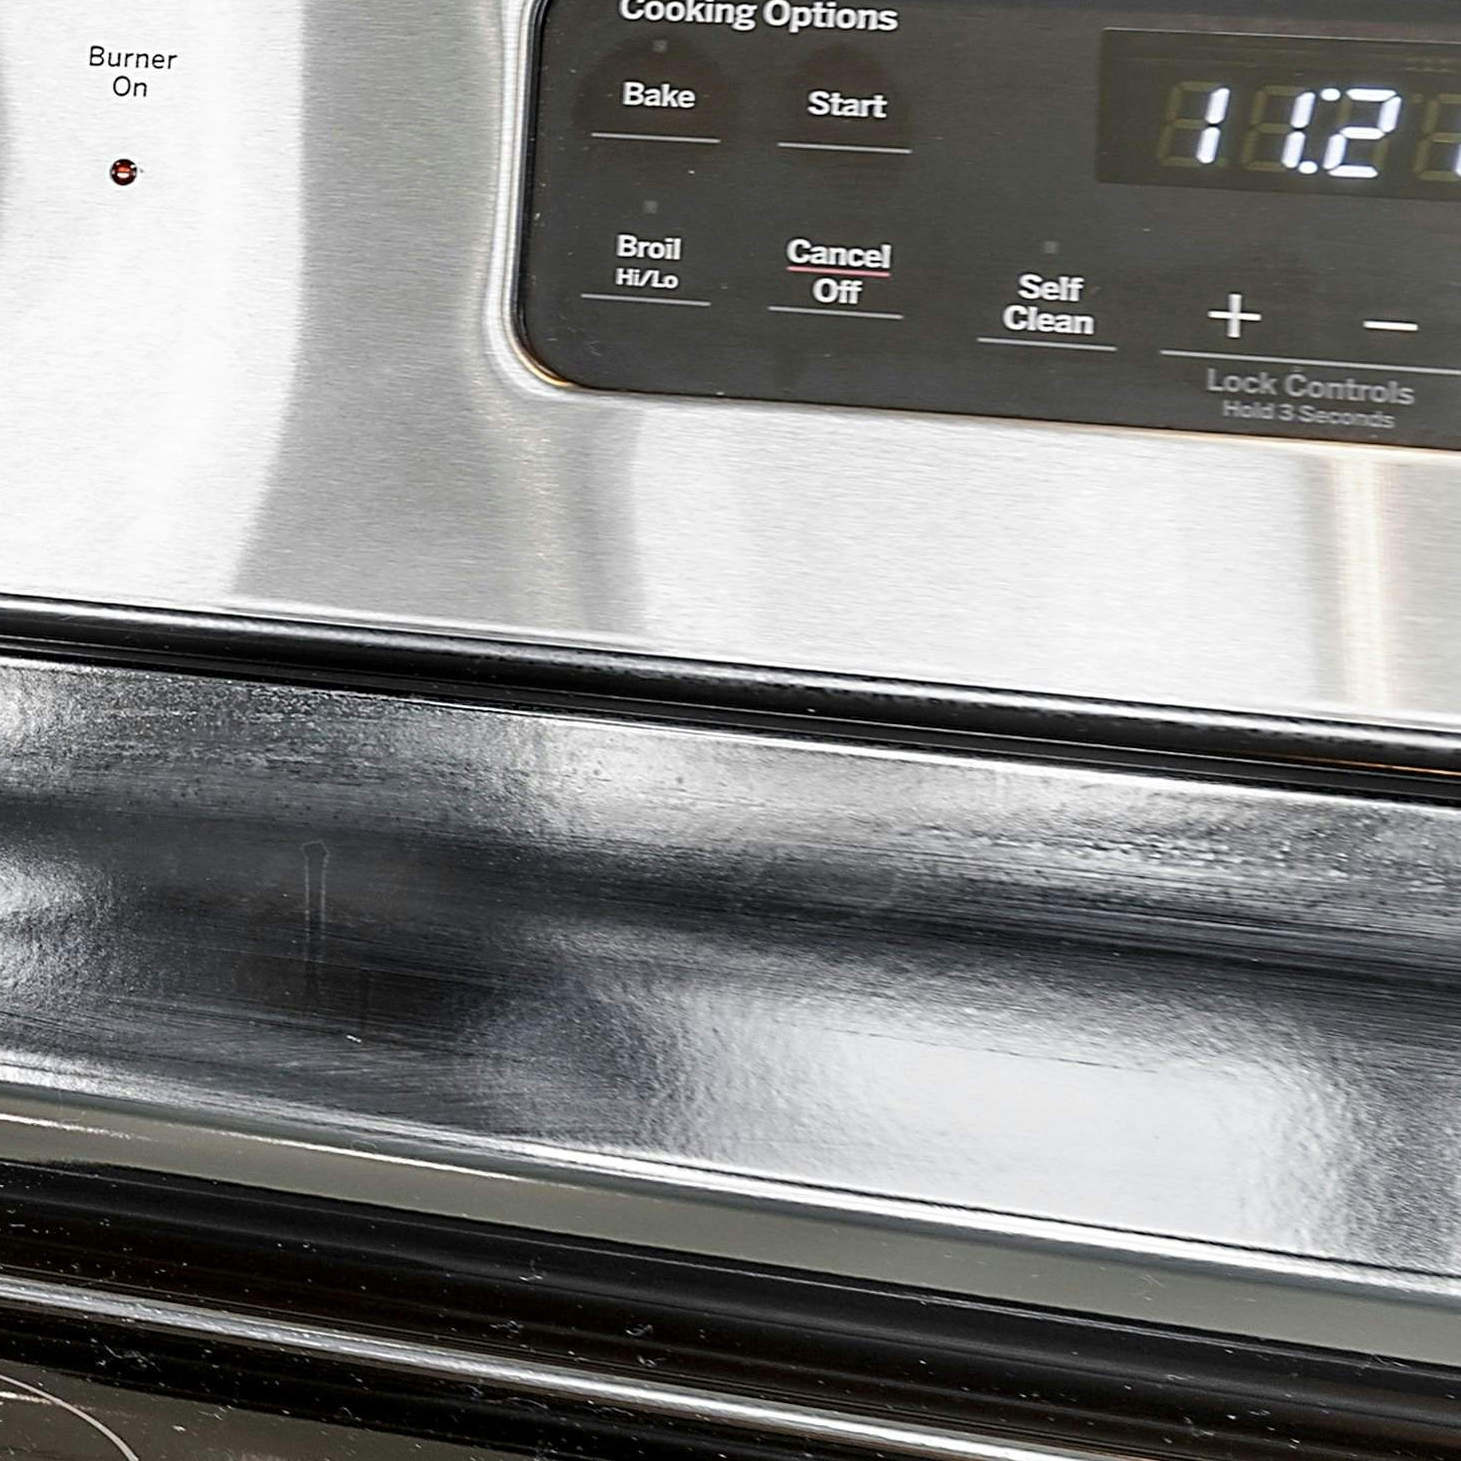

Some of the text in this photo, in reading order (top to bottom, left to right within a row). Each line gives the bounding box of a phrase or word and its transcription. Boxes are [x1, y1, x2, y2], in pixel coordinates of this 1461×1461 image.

[89, 45, 178, 70] Burner
[113, 75, 148, 98] On
[622, 80, 696, 108] Bake
[807, 90, 888, 119] Start
[1196, 86, 1461, 179] 11:2
[616, 233, 682, 261] Broil
[787, 237, 891, 269] Cancel
[616, 267, 679, 290] Hi/Lo
[812, 277, 863, 305] Off
[1018, 273, 1084, 303] Self
[1002, 304, 1094, 336] Clean
[1206, 368, 1415, 405] Lock Controls
[1222, 398, 1396, 429] Hold 3 Seconds
